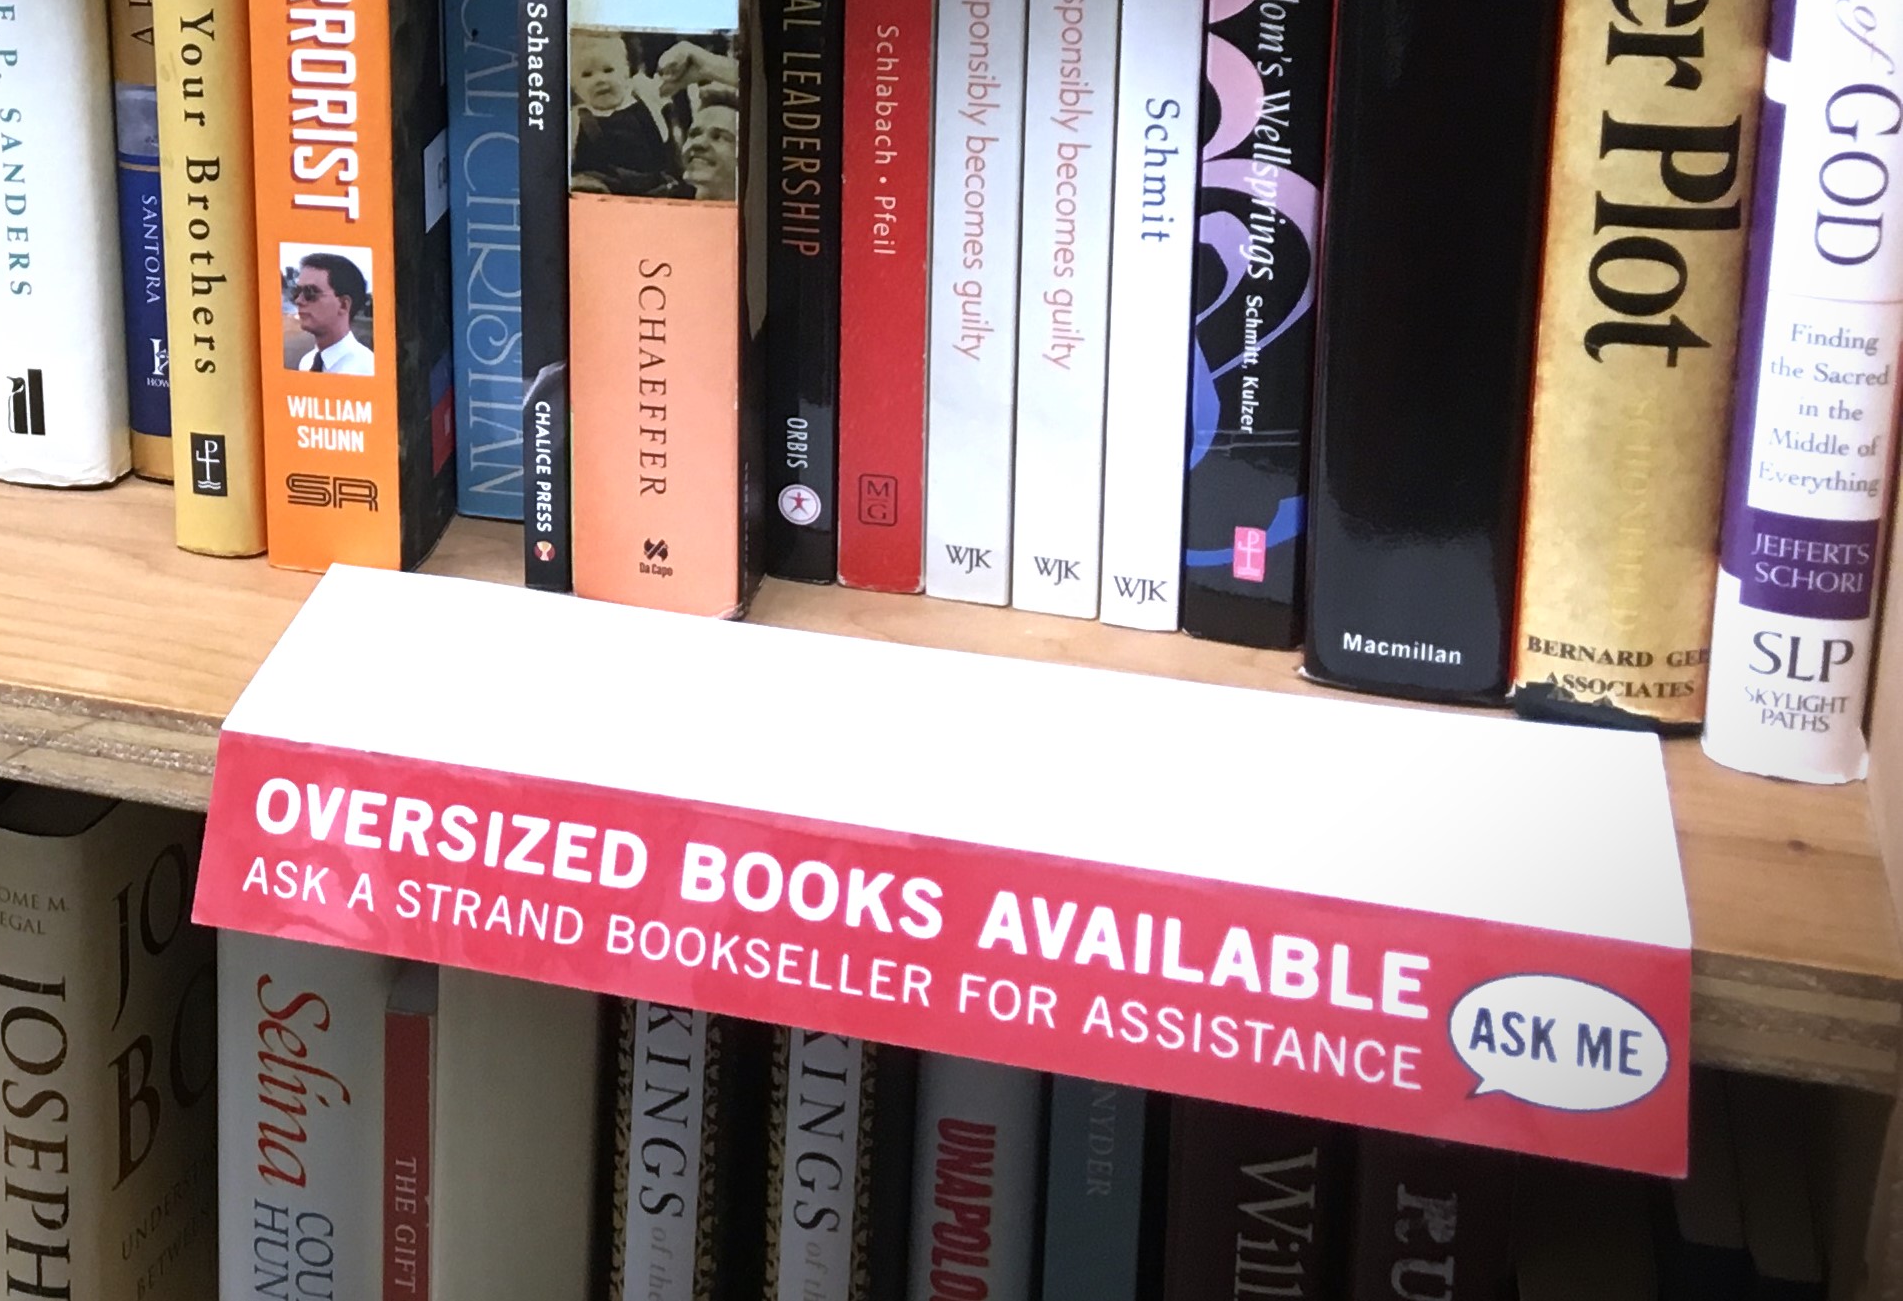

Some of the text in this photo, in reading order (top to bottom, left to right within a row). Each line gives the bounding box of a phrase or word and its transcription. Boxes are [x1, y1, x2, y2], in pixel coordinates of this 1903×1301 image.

[179, 8, 217, 127] Your
[526, 2, 551, 130] Schaefer
[874, 24, 900, 166] Schlabach
[781, 47, 821, 258] LEADERSHIP
[963, 137, 999, 271] becomes
[1142, 99, 1180, 244] Schmit
[1246, 89, 1291, 282] Wellsprings
[1813, 81, 1903, 267] GOD
[141, 194, 161, 305] SANTORA
[185, 156, 229, 376] Brothers
[1584, 110, 1743, 367] Plot
[288, 395, 372, 425] WILLIAM
[297, 425, 364, 452] SHUNN
[638, 259, 673, 498] SCHAEFFER
[786, 417, 808, 470] ORBIS
[1241, 376, 1260, 434] Kulzer
[534, 400, 553, 533] CHALICE PRESS
[1752, 531, 1869, 565] JEFFERTS
[1342, 632, 1463, 666] Macmillan
[1526, 636, 1653, 668] BERNARD
[1748, 631, 1853, 683] SLP
[254, 777, 1432, 1020] OVERSIZED BOOKS AVAILABLE
[242, 857, 1422, 1092] ASK A STRAND BOOKSELLER FOR ASSISTANCE
[256, 973, 352, 1189] Selina
[1468, 1008, 1644, 1077] ASK ME
[392, 1156, 416, 1293] THE GIFT
